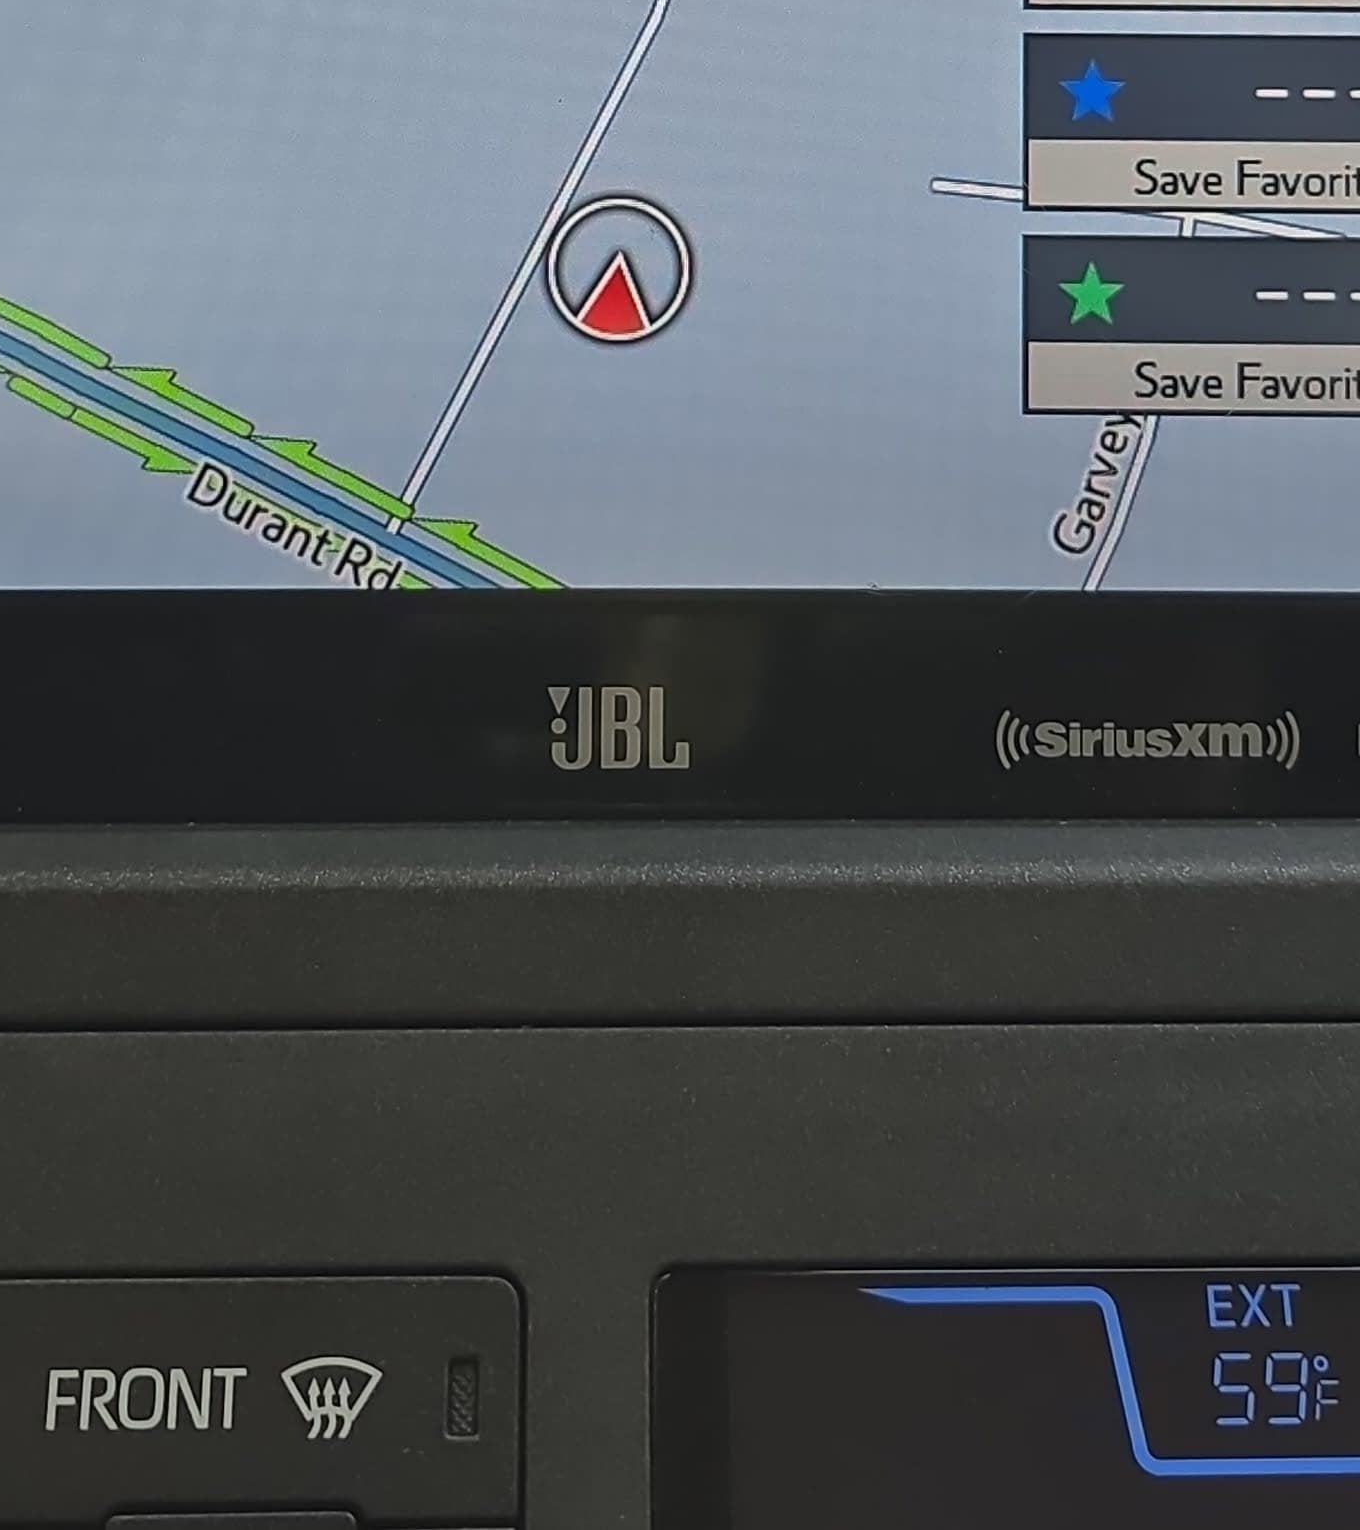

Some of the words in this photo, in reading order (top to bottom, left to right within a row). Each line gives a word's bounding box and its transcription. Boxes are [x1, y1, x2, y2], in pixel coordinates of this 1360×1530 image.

[1133, 158, 1224, 197] Save
[1133, 360, 1224, 400] Save
[1053, 414, 1142, 554] Garvey
[187, 463, 332, 567] Durant
[334, 537, 403, 590] Rd
[547, 685, 690, 771] JBL
[1205, 1283, 1302, 1329] EXT
[44, 1366, 249, 1431] FRONT
